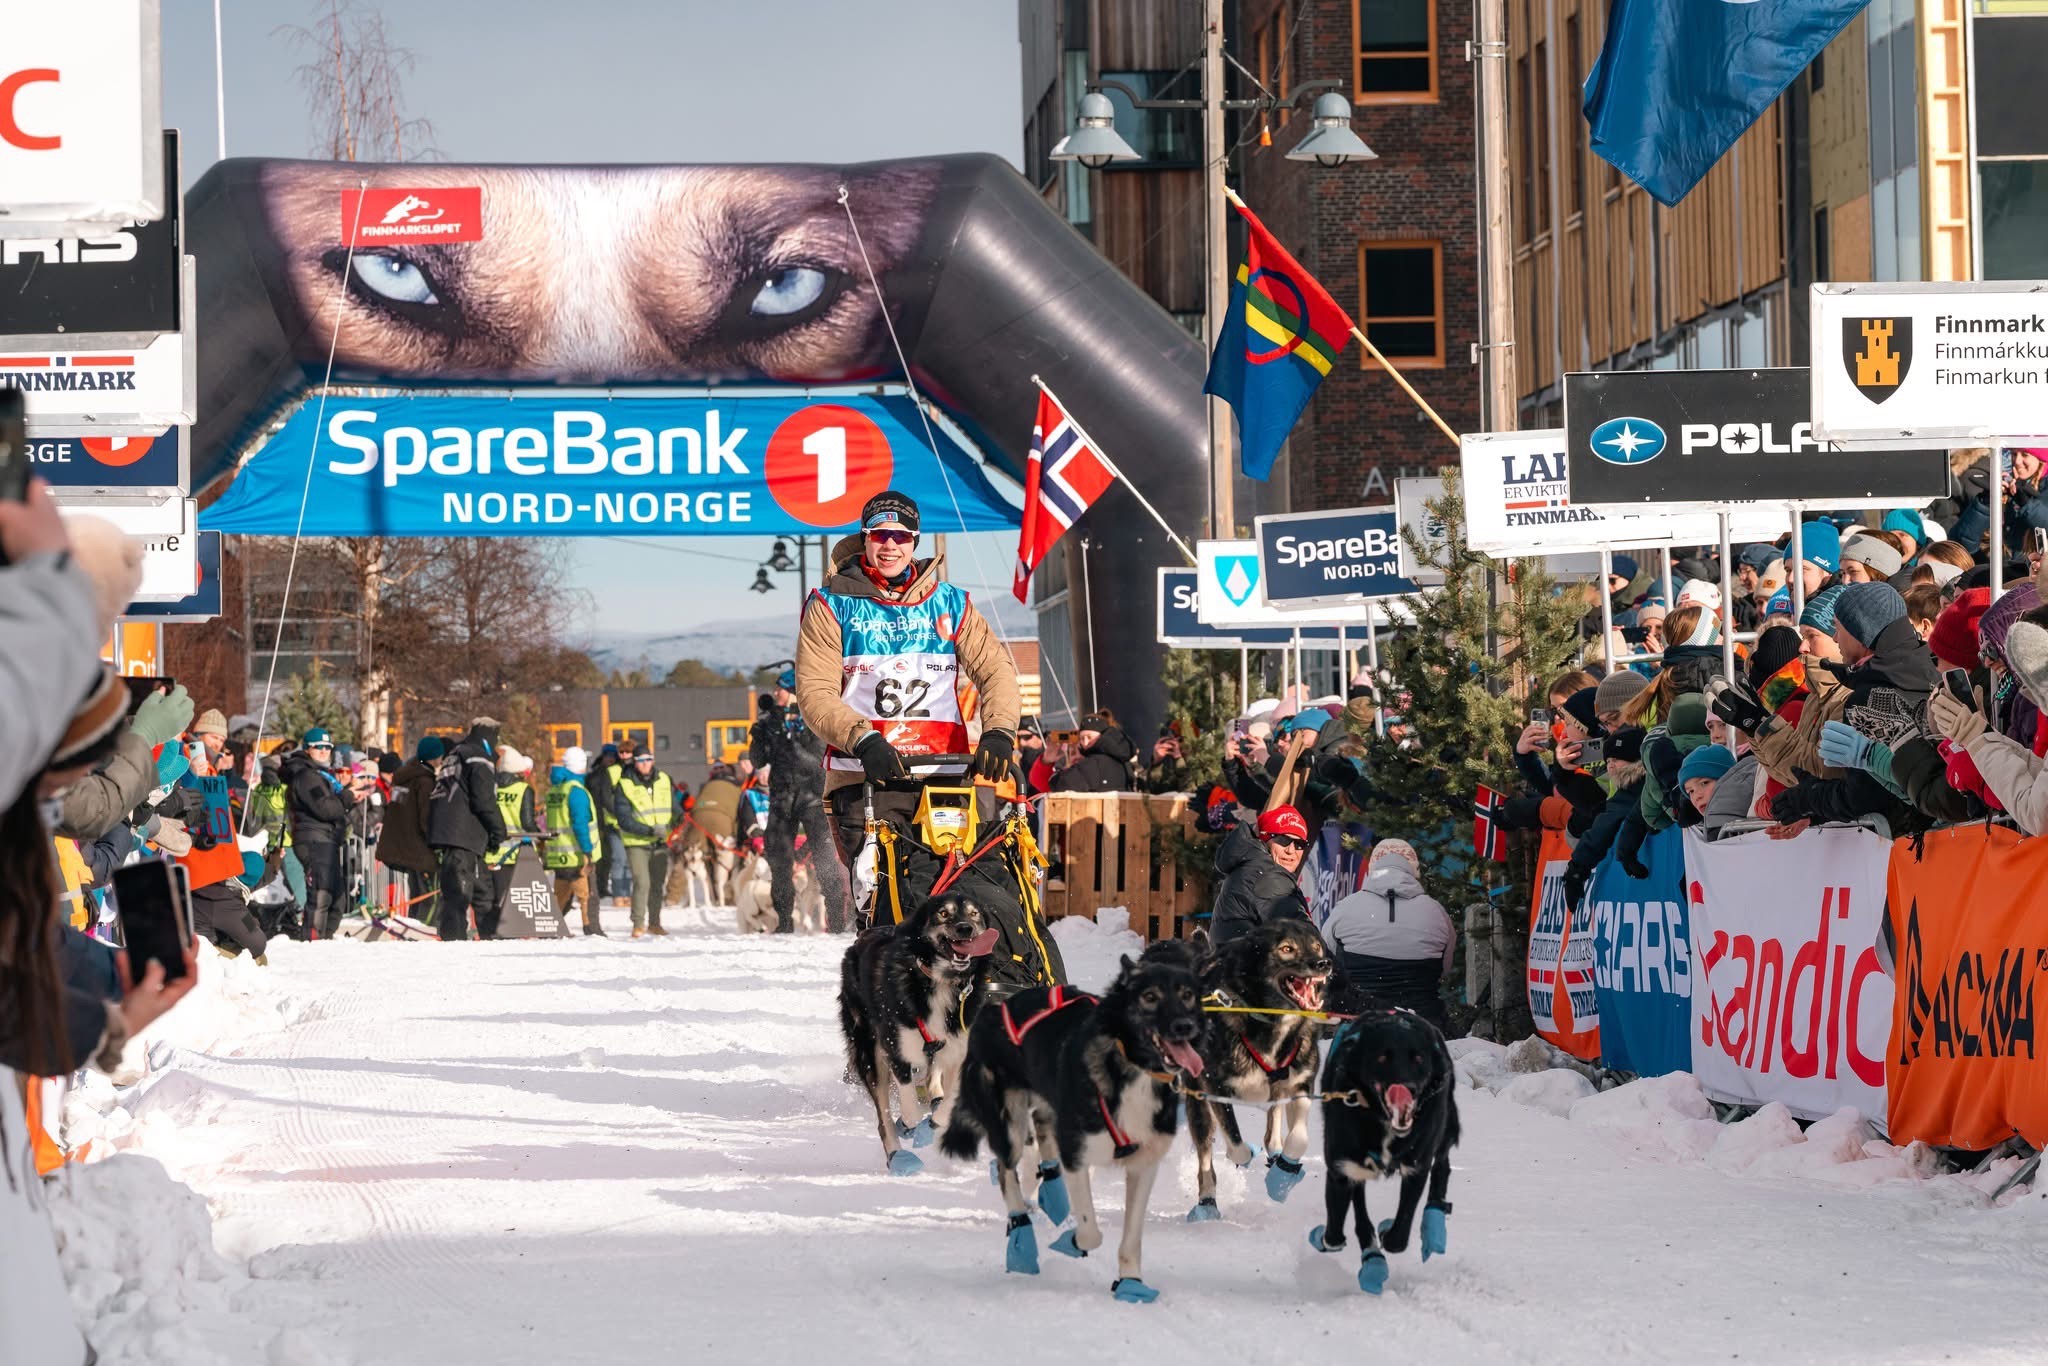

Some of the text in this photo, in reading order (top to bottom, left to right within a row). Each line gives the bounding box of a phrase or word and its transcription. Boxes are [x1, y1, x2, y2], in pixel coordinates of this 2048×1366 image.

[362, 223, 461, 237] FINNMARKSLØPET
[1935, 314, 2045, 333] Finnmark
[1935, 342, 2048, 359] Finnmárkku
[1935, 367, 2038, 385] Finmarkun
[1682, 422, 1841, 455] POLA
[328, 409, 847, 504] SpareBank 1
[1504, 487, 1522, 498] ER
[443, 491, 751, 523] NORD-NORGE
[1506, 508, 1605, 526] FINNMAR
[850, 615, 935, 633] SpareBank
[874, 678, 931, 718] 62
